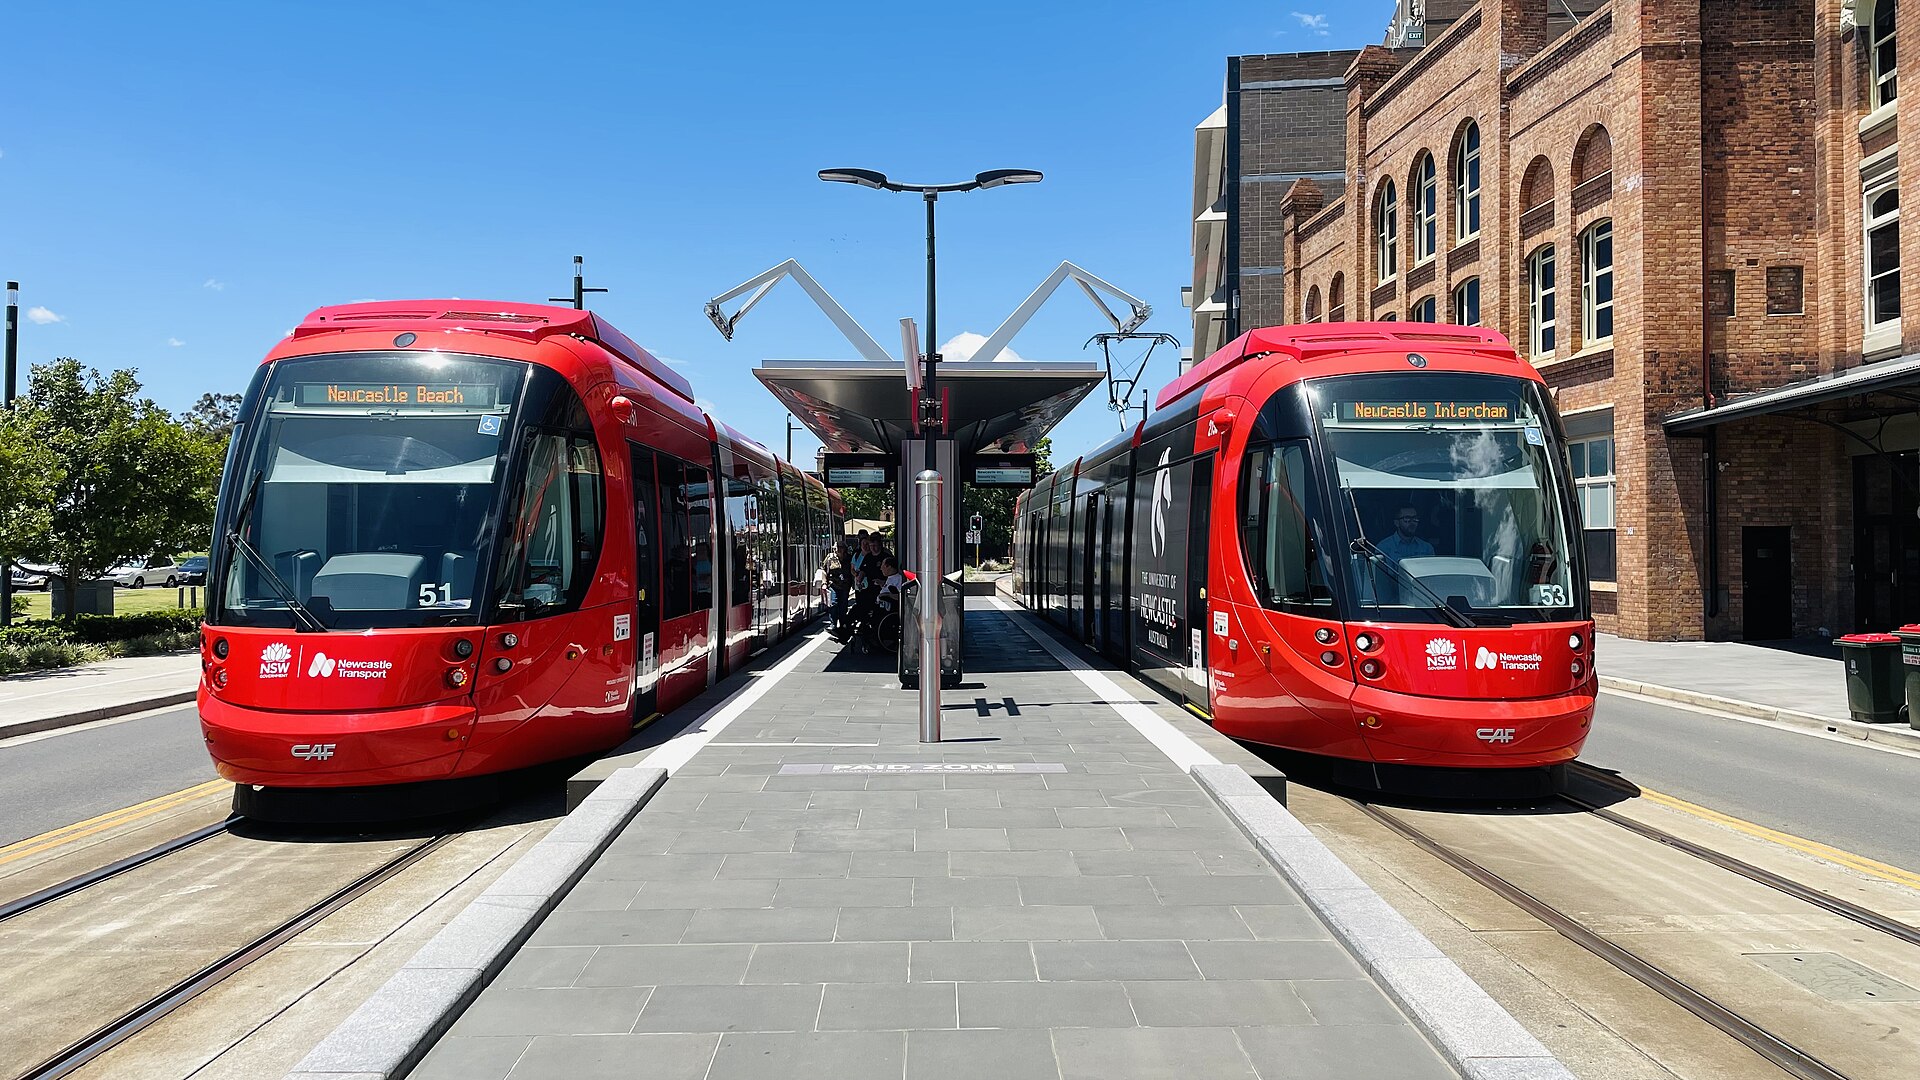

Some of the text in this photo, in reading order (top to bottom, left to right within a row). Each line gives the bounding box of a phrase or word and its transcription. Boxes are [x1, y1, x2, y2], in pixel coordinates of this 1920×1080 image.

[327, 385, 464, 404] Newcastle Beach
[1355, 402, 1508, 418] Newcastle Interchan
[1170, 574, 1177, 590] OF
[419, 582, 451, 607] 51
[1539, 584, 1566, 606] 53
[1140, 592, 1177, 629] NEWCASTLE
[338, 659, 393, 670] Newcastle
[1426, 655, 1457, 667] NSW
[1500, 653, 1543, 663] Newcastle
[1500, 660, 1540, 672] Transport
[260, 662, 290, 674] NSW
[338, 668, 387, 680] Transport
[1475, 727, 1516, 744] CAF
[290, 743, 337, 761] CAF
